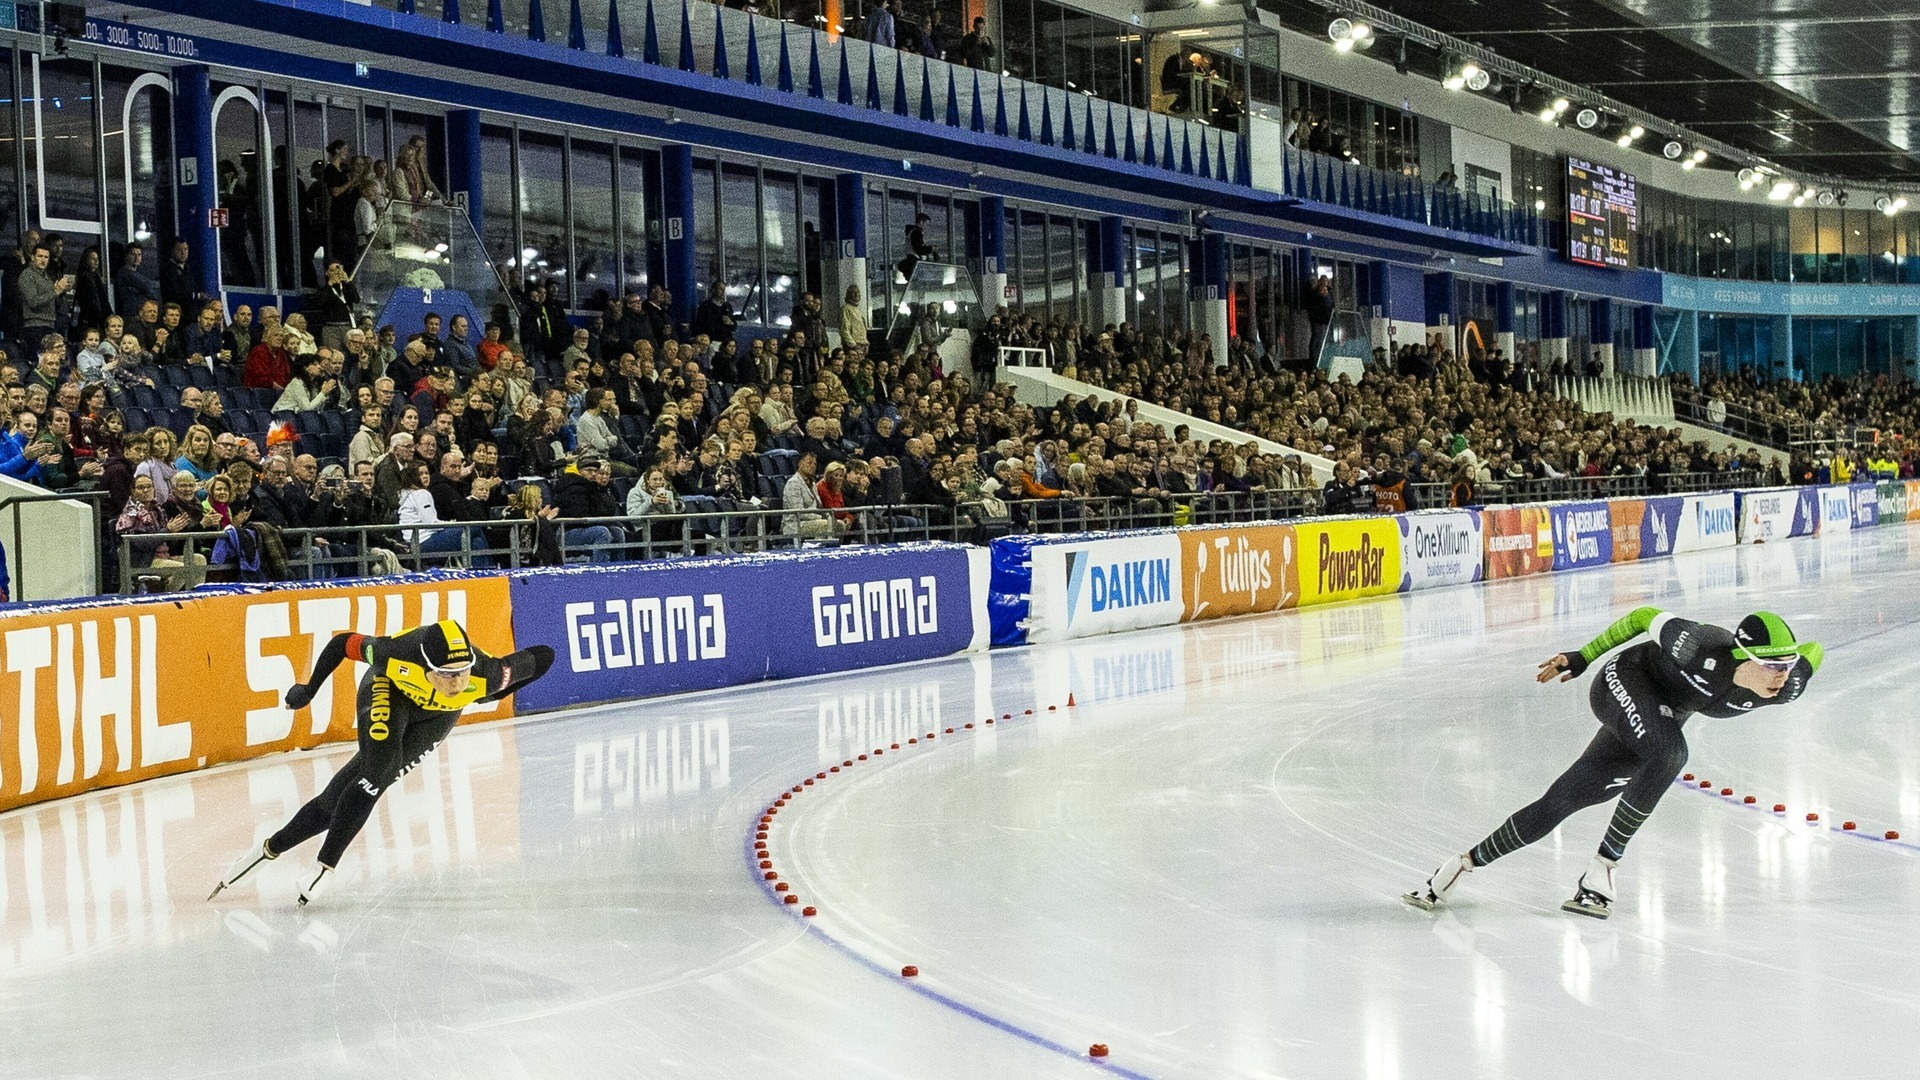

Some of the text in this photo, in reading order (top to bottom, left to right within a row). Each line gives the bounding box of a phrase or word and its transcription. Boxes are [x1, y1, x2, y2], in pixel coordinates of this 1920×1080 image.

[1415, 523, 1470, 559] OneXillium
[1704, 507, 1734, 536] DAIKIN
[1091, 558, 1171, 613] DAIKIN
[1215, 535, 1271, 607] Tulips
[1317, 532, 1385, 595] PowerBar
[0, 614, 193, 796] TIHL
[369, 674, 390, 741] JUMBO
[358, 777, 380, 797] FILA
